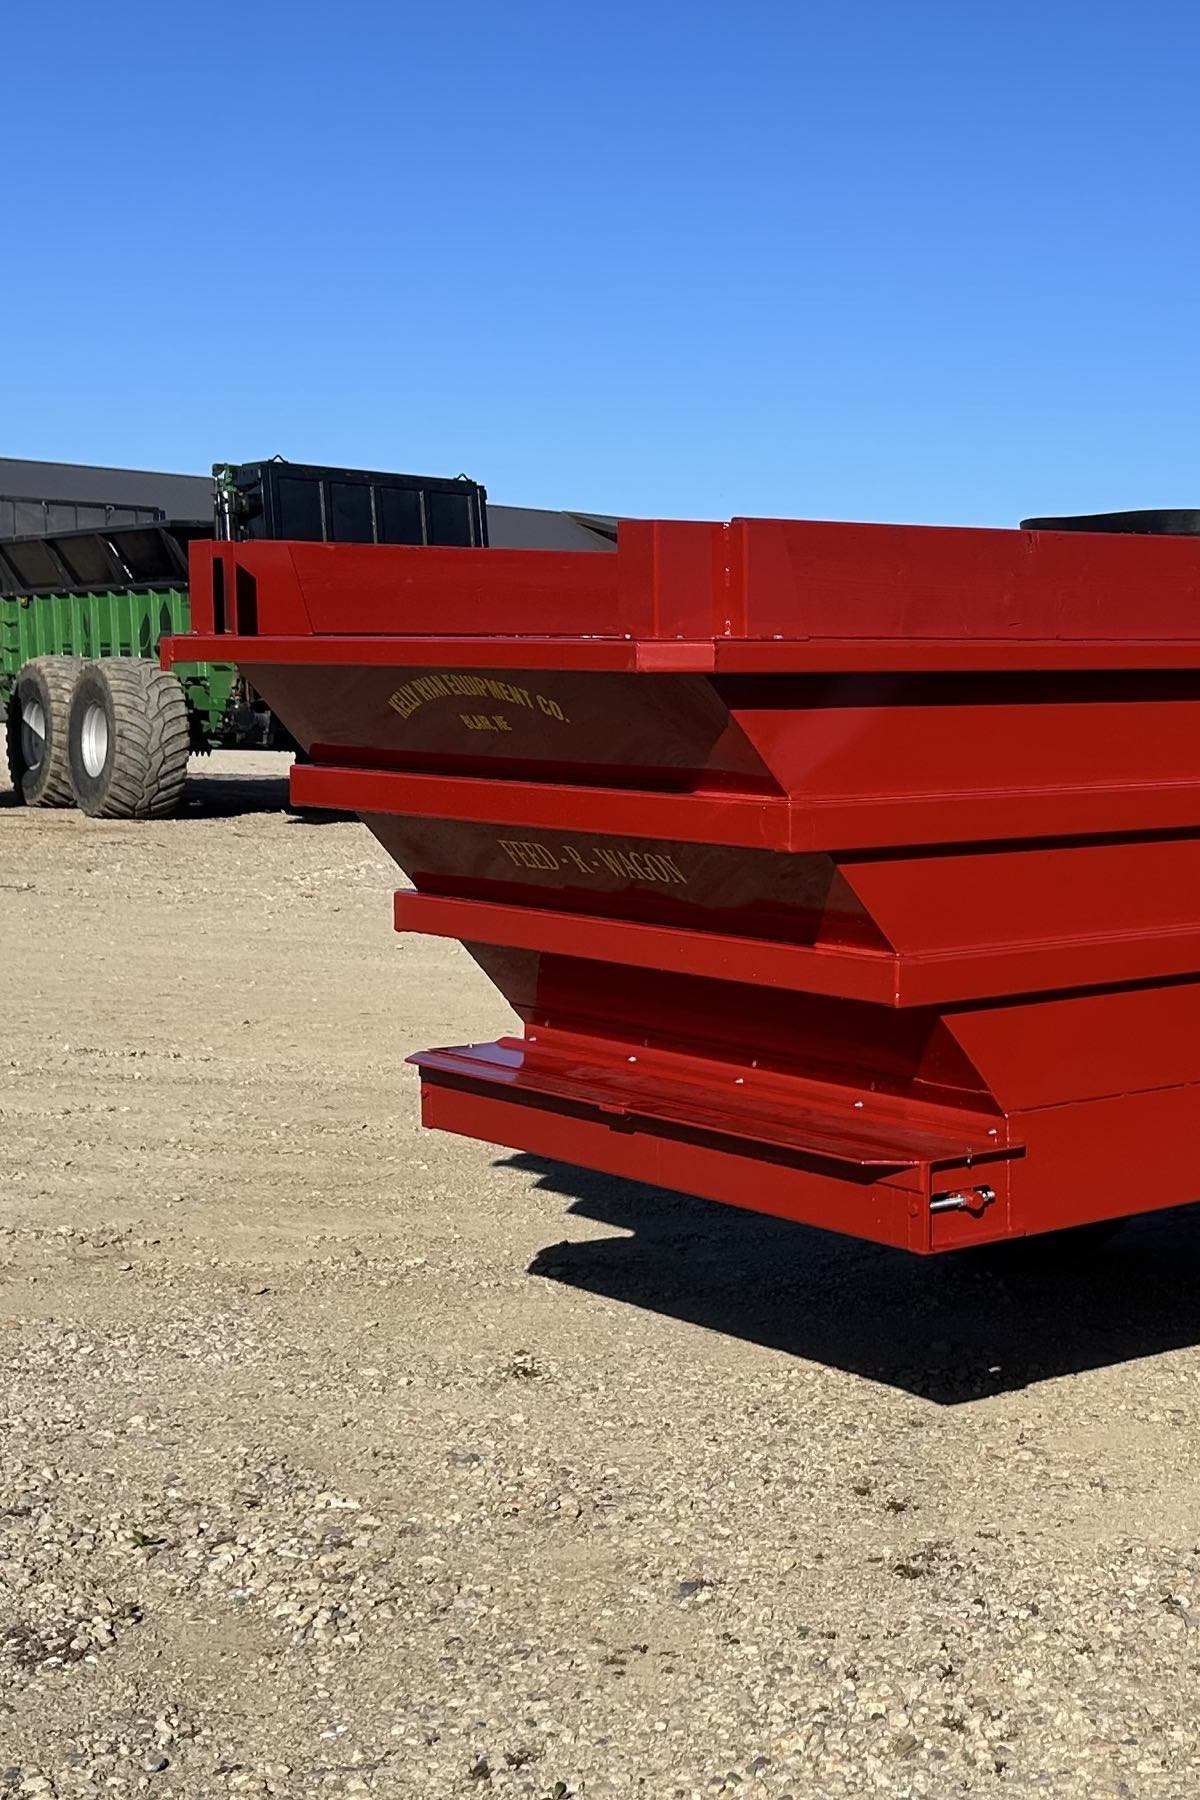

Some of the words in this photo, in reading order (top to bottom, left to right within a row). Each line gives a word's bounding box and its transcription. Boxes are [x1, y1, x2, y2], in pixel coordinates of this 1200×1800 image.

[388, 683, 423, 719] KELLY
[410, 675, 452, 701] RYAN
[441, 674, 534, 710] EQUIPMENT
[536, 694, 571, 724] CO.
